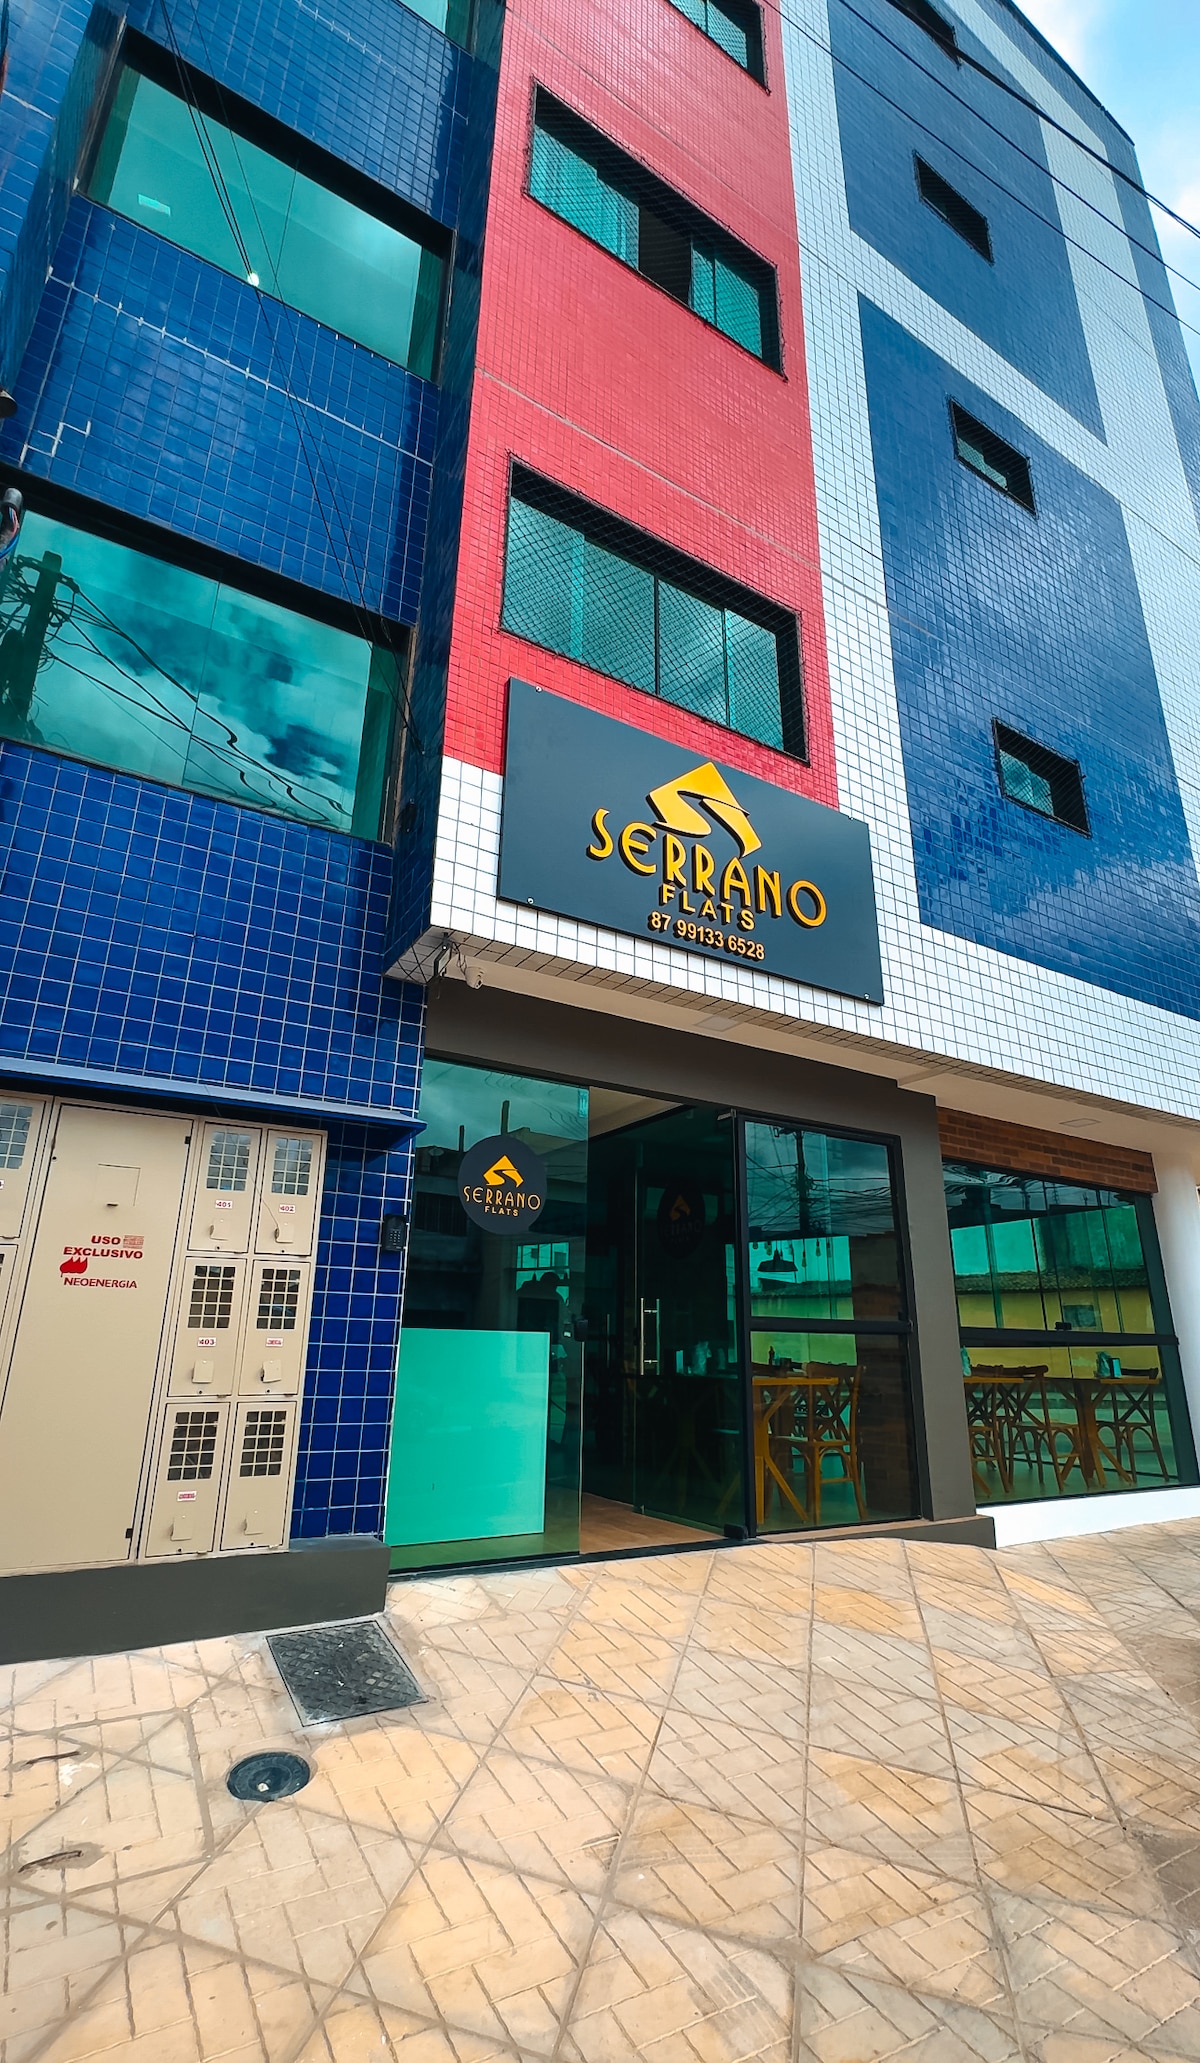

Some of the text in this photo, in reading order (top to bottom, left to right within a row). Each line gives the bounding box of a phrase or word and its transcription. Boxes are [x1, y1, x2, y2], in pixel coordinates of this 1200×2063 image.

[586, 807, 828, 929] SERRANO
[659, 883, 756, 931] FLATS
[648, 910, 766, 961] 87 99133 6528
[463, 1185, 541, 1210] SERRANO
[484, 1205, 519, 1217] FLATS
[91, 1235, 121, 1245] USO
[63, 1246, 143, 1259] EXCLUSIVO
[63, 1277, 137, 1288] NEOENERGIA
[199, 1338, 215, 1346] 403
